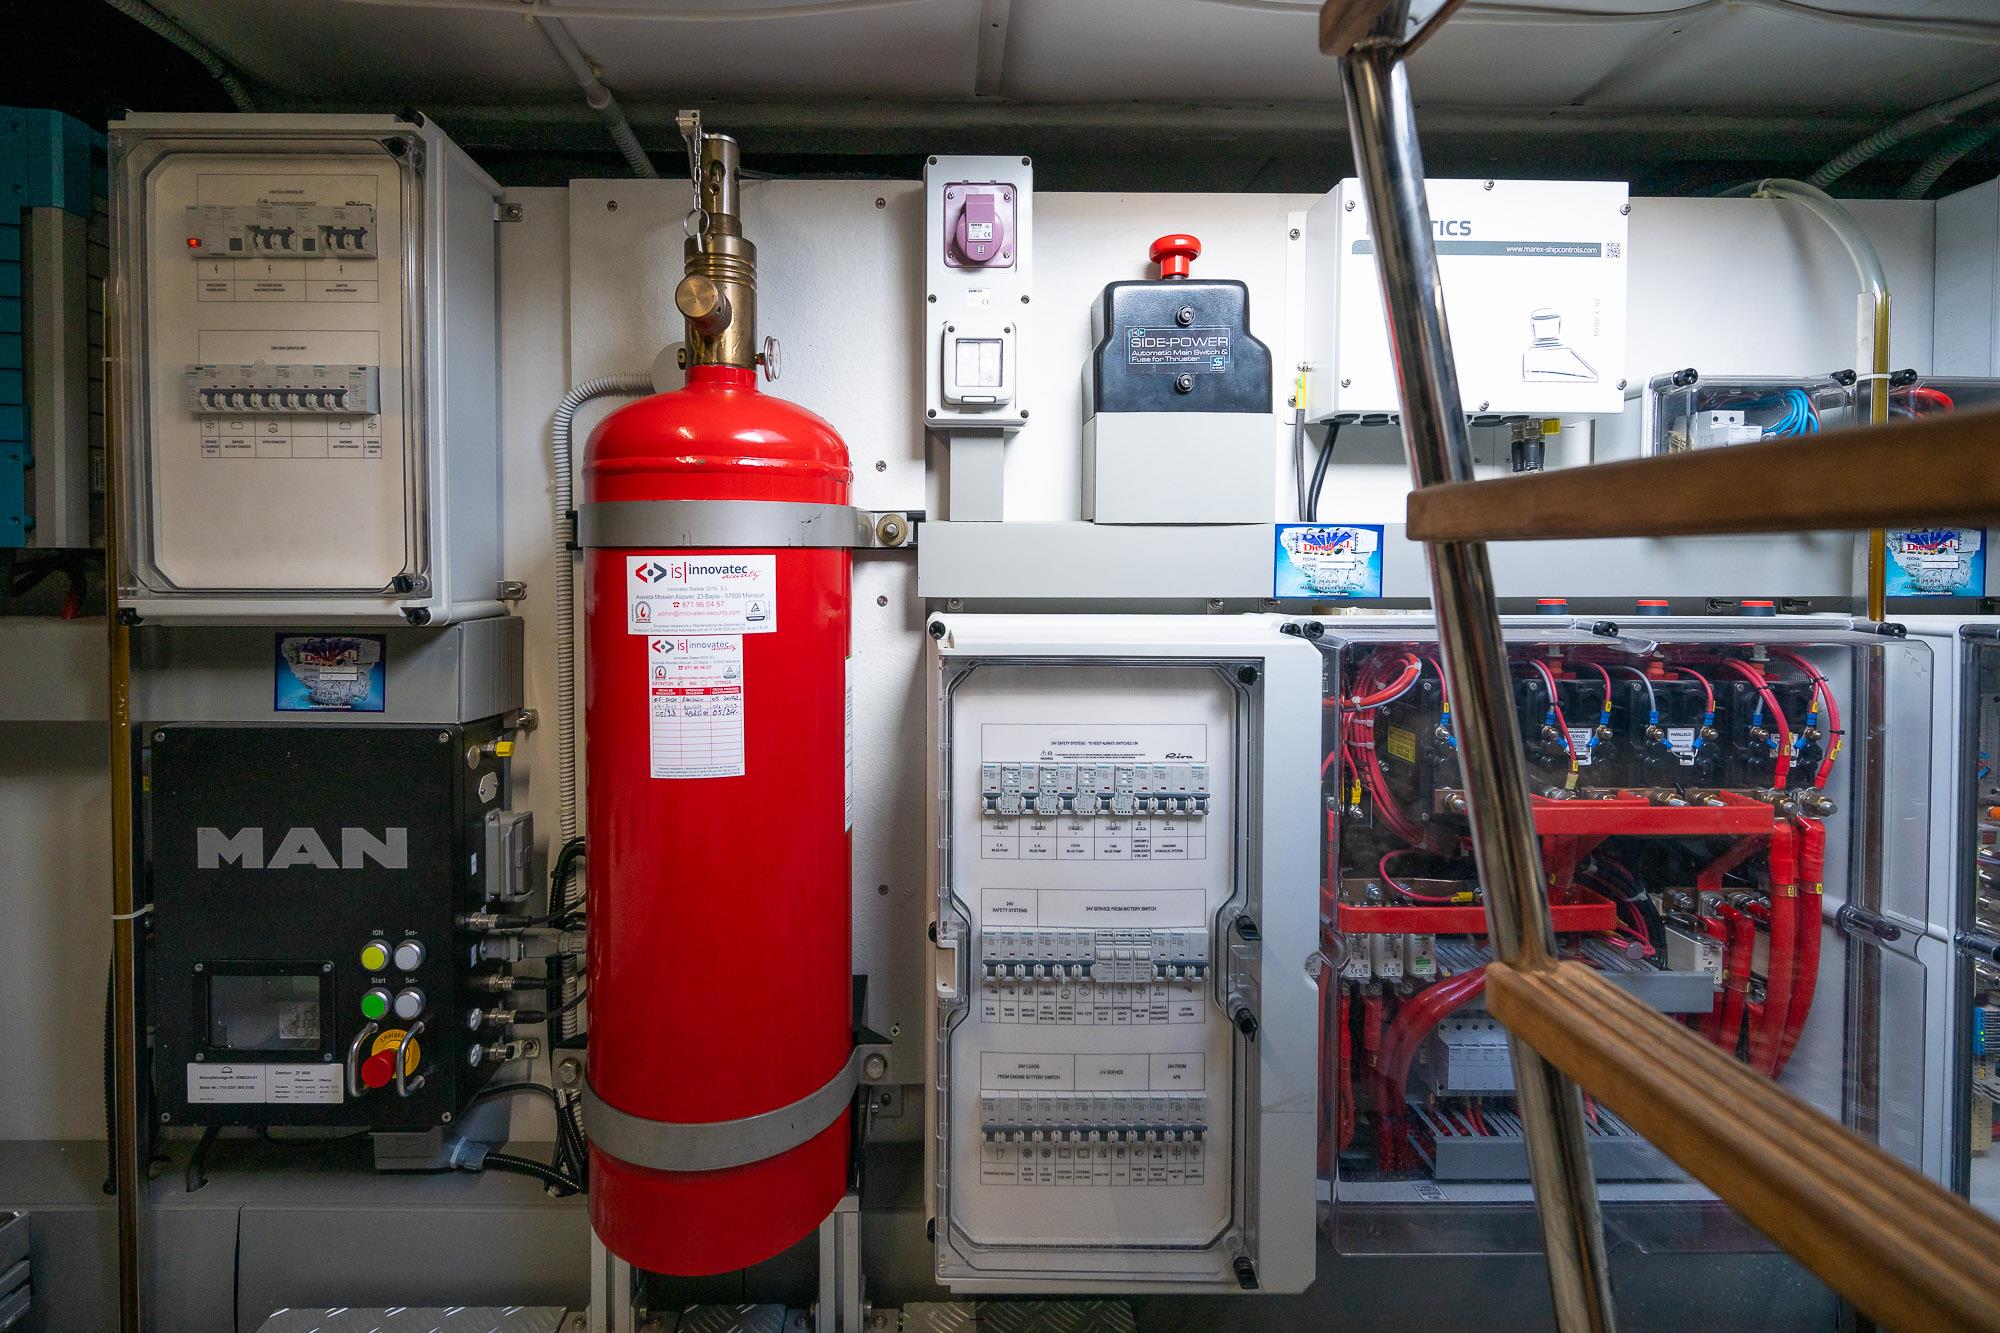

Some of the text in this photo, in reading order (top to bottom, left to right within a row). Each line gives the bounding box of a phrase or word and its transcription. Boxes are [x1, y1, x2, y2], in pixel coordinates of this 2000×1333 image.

[1430, 220, 1473, 237] TICS
[1505, 245, 1598, 255] www.marex-shipcontrols.com
[1130, 336, 1229, 348] SIDE-POWER
[1131, 349, 1172, 357] Automatic
[1193, 348, 1220, 356] Switch
[1303, 541, 1335, 552] Diesel
[1906, 541, 1939, 551] Diesel
[671, 563, 748, 579] is innovatec
[677, 640, 730, 651] is innovatec
[1165, 752, 1193, 760] Riva
[197, 827, 408, 869] MAN
[372, 928, 384, 937] IGN
[371, 976, 387, 985] Start
[380, 1032, 404, 1043] Emergen
